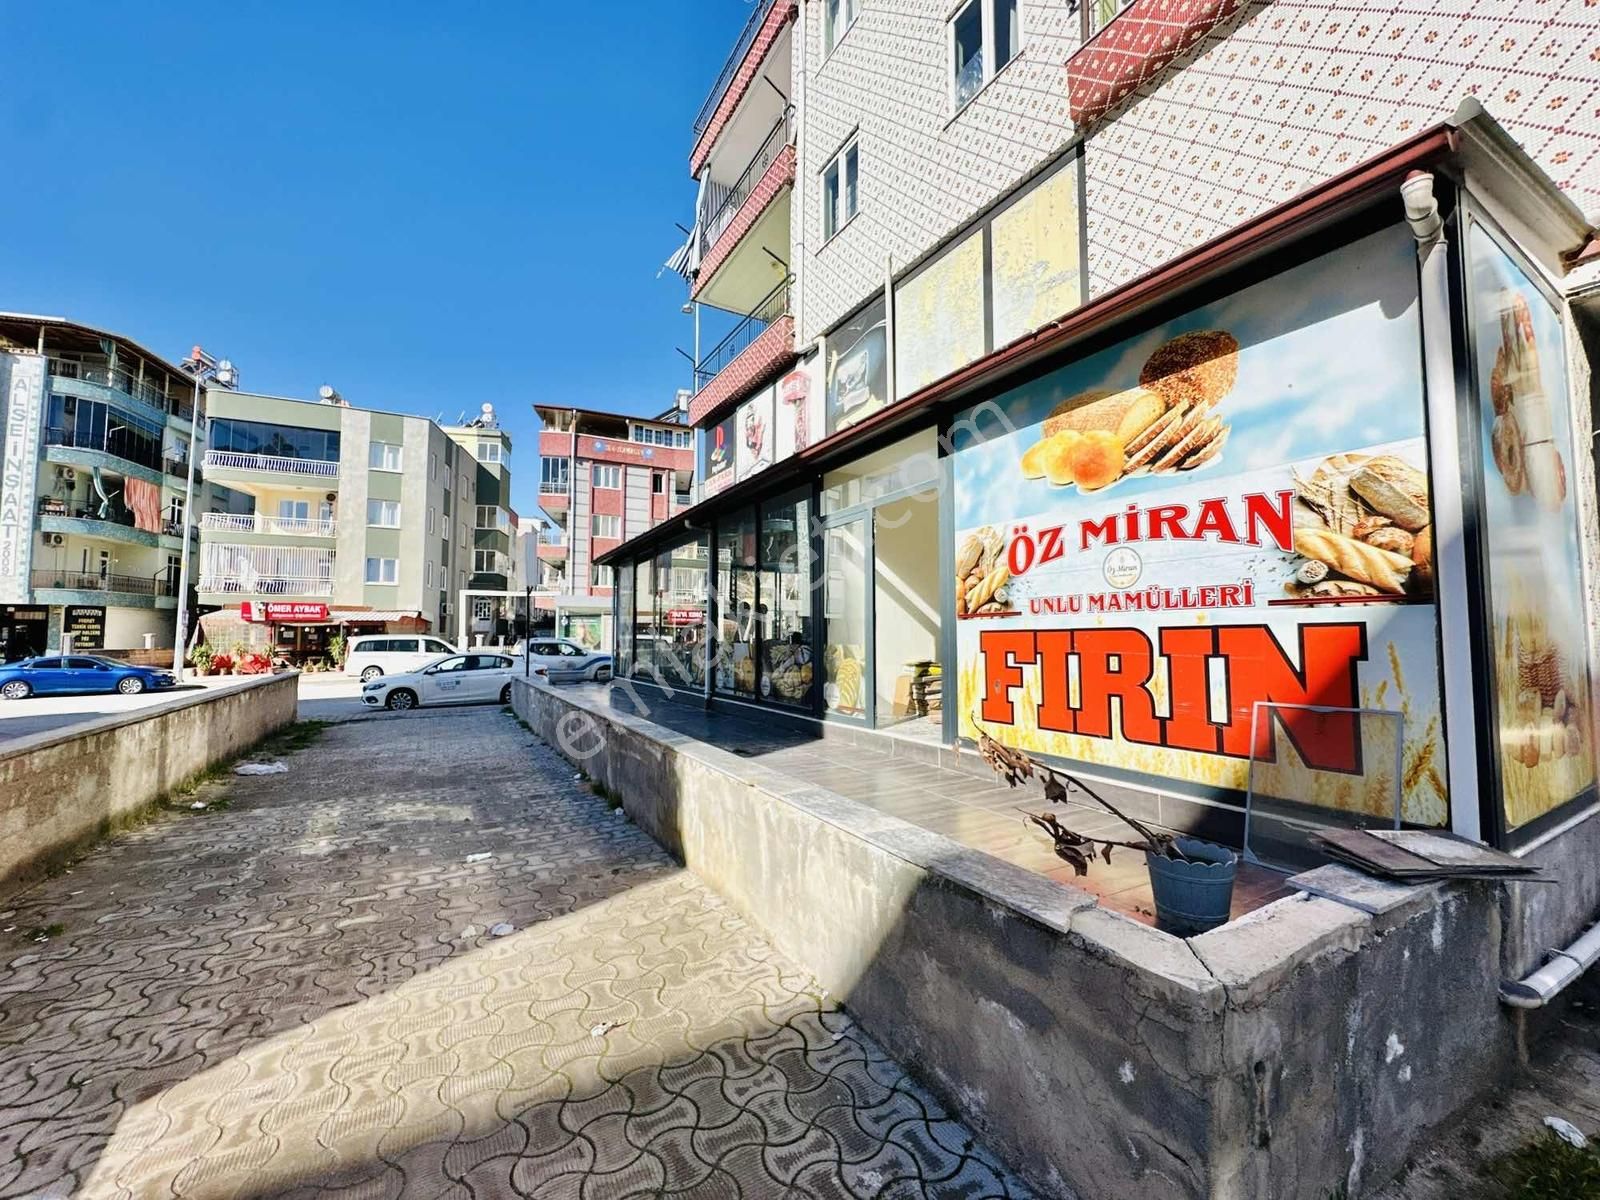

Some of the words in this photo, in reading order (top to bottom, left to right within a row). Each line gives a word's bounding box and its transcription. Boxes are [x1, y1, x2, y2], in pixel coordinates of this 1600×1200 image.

[1007, 523, 1067, 578] ÖZ
[1079, 489, 1296, 553] MİRAN
[267, 604, 292, 613] ÖMER
[1029, 593, 1084, 615] UNLU
[1086, 577, 1256, 613] MAMÜLLERİ
[979, 621, 1368, 777] FIRIN
